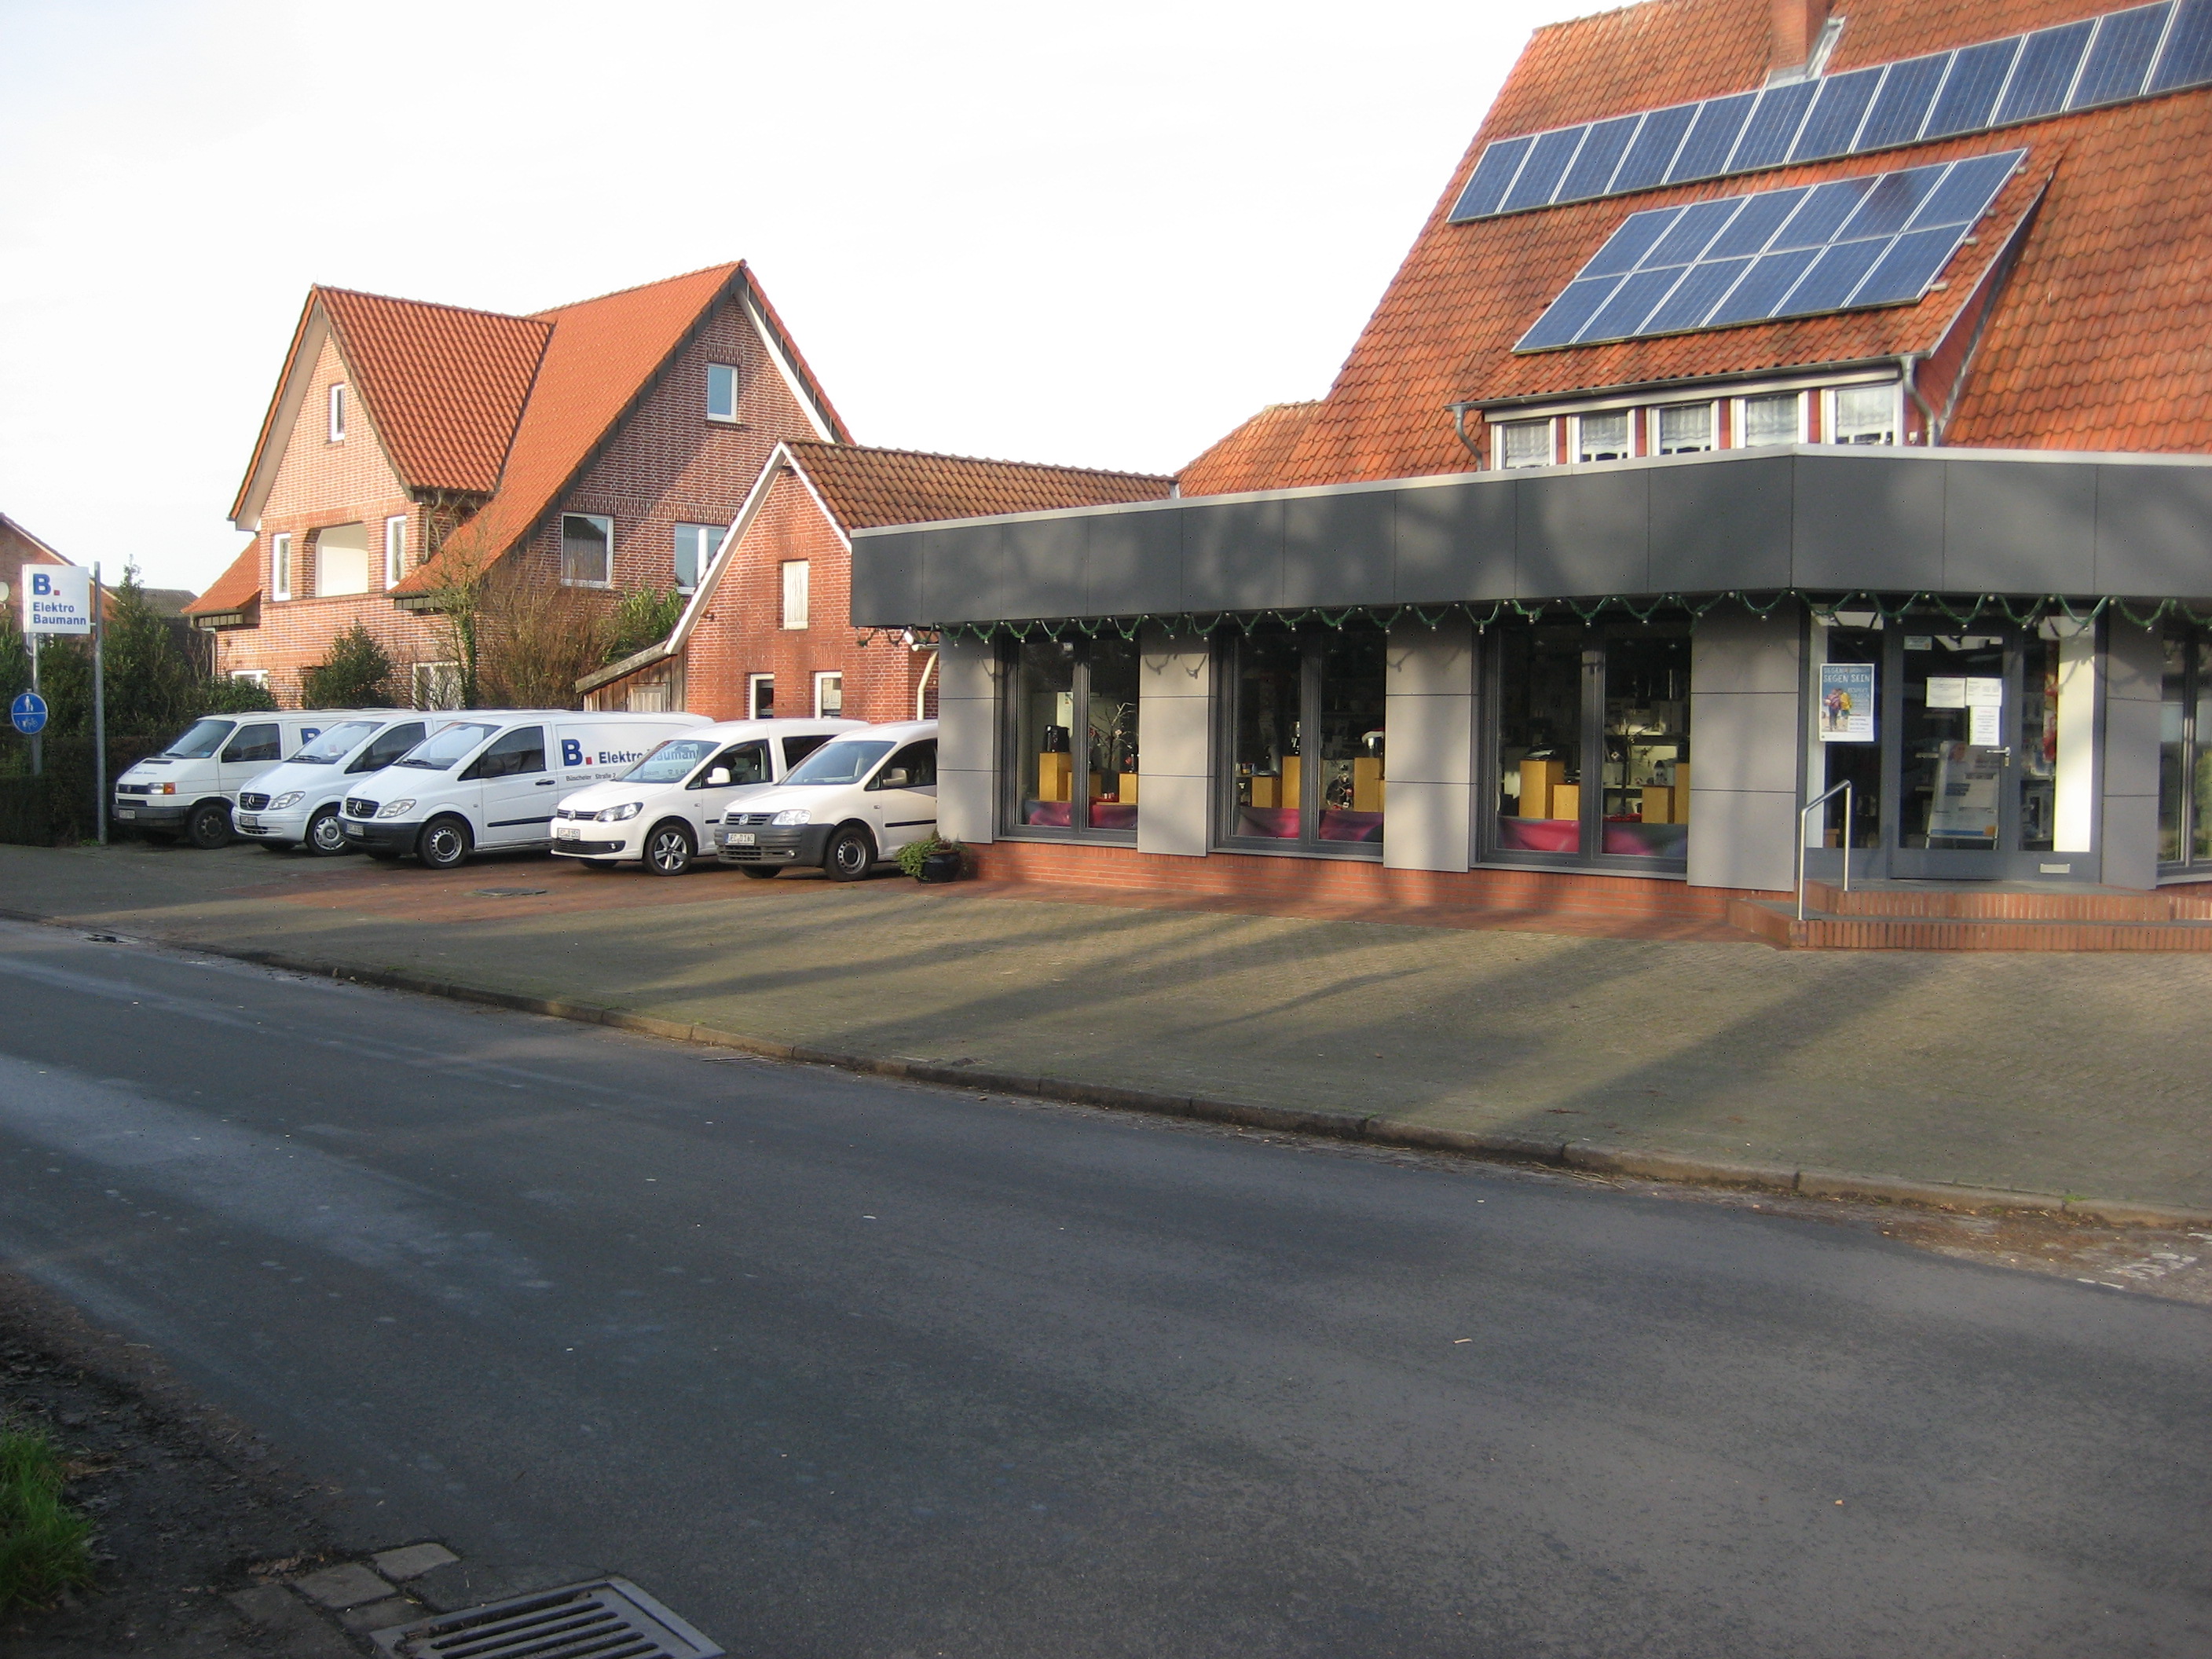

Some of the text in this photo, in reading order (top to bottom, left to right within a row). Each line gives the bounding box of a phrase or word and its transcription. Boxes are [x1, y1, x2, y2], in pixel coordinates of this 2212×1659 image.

[33, 573, 60, 595] B.
[33, 602, 75, 613] Elektro
[33, 614, 86, 625] Baumann
[1823, 674, 1870, 683] SEGEN SEIN
